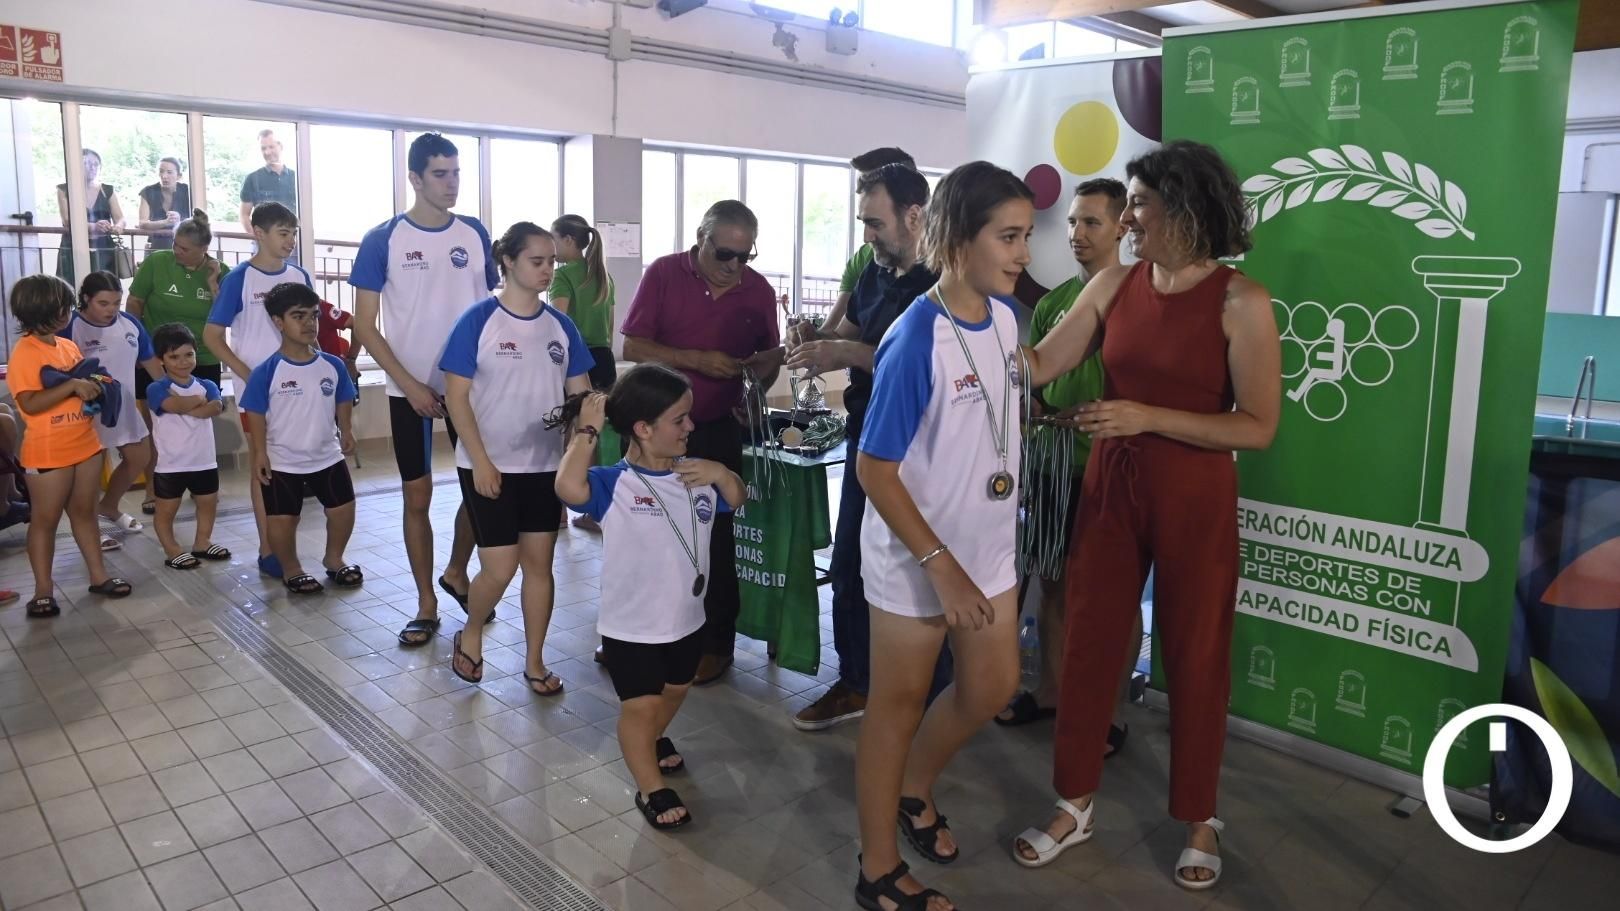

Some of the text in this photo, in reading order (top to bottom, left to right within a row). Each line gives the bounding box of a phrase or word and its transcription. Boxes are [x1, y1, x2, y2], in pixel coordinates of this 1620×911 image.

[24, 66, 61, 76] PULSADOR
[35, 73, 62, 81] ALARMA
[735, 544, 764, 565] ONAS
[1237, 507, 1462, 572] ERACIÓN ANDALUZA
[735, 563, 786, 588] CAPACID
[1254, 545, 1380, 585] DEPORTES
[1387, 572, 1422, 594] DE
[1244, 562, 1431, 616] PERSONAS CON
[1238, 589, 1452, 658] APACIDAD FÍSICA
